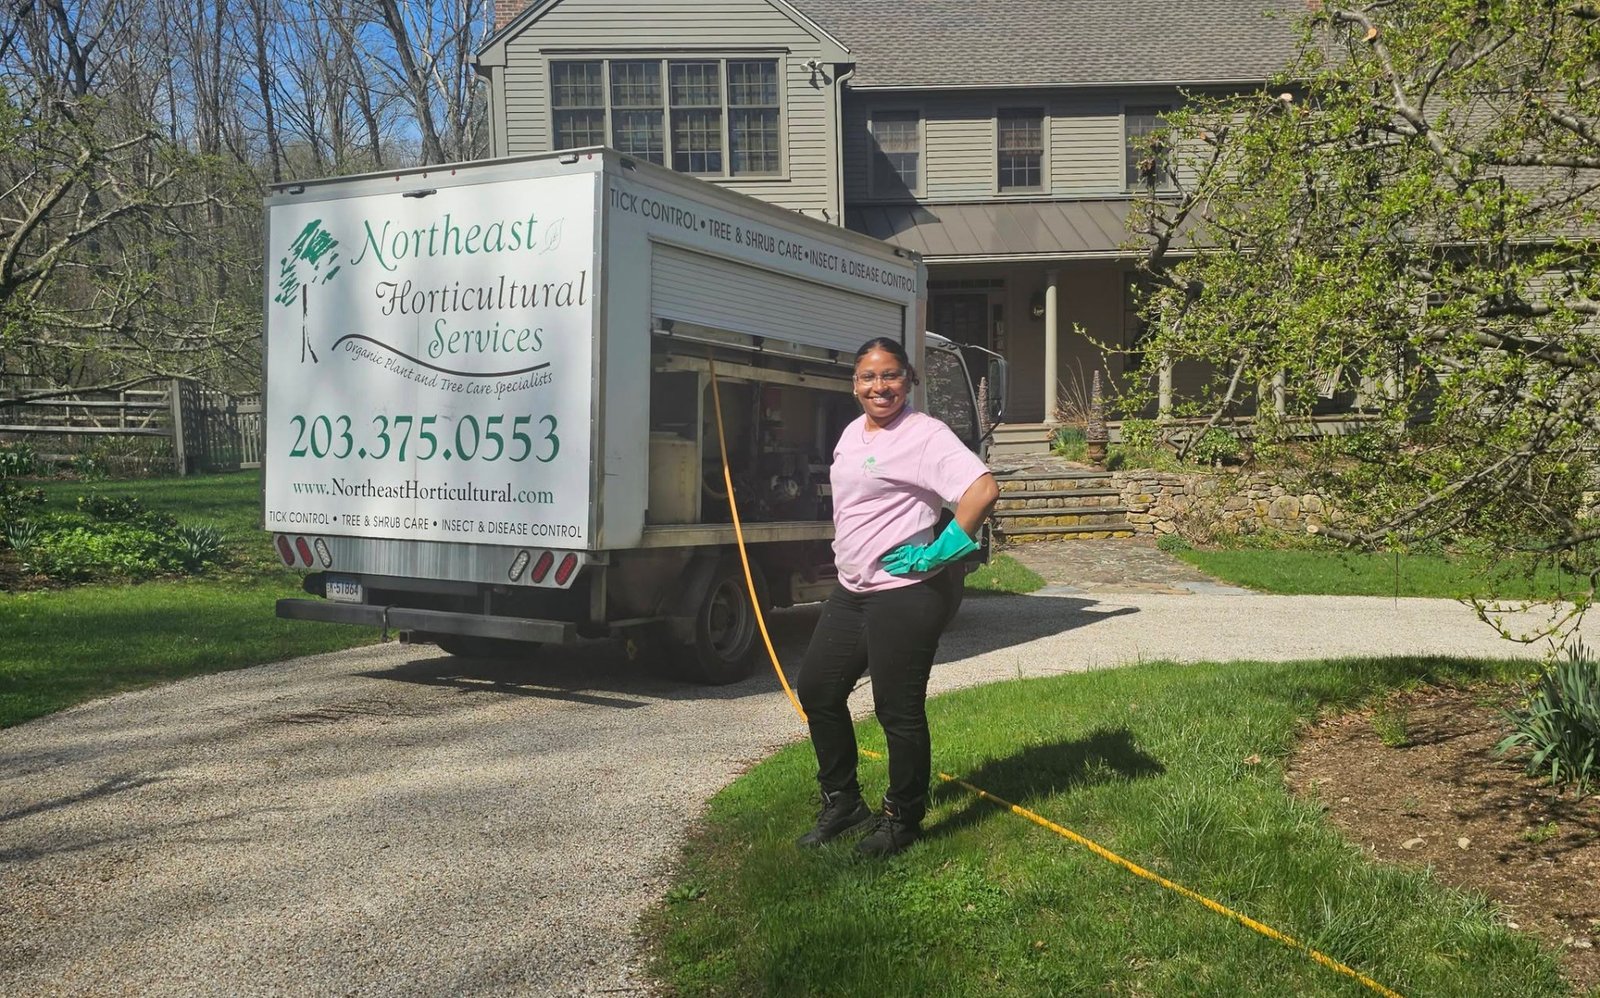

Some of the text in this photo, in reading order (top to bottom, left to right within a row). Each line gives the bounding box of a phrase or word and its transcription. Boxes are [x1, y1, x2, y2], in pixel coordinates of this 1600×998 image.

[350, 213, 538, 272] Northeast
[609, 187, 916, 293] TICK CONTROL TREE & SHRUB CARE INSECT & DISEASE CONTROL
[375, 268, 587, 316] Horticultural
[427, 318, 543, 359] Services
[345, 340, 553, 400] Organic Plant and Tree Care Specialists
[288, 414, 560, 463] 203.375.0553
[293, 477, 554, 504] www.NortheastHorticultural.com
[269, 510, 582, 538] TICK CONTROL TREE & SHRUB CARE INSECT & DISEASE CONTROL
